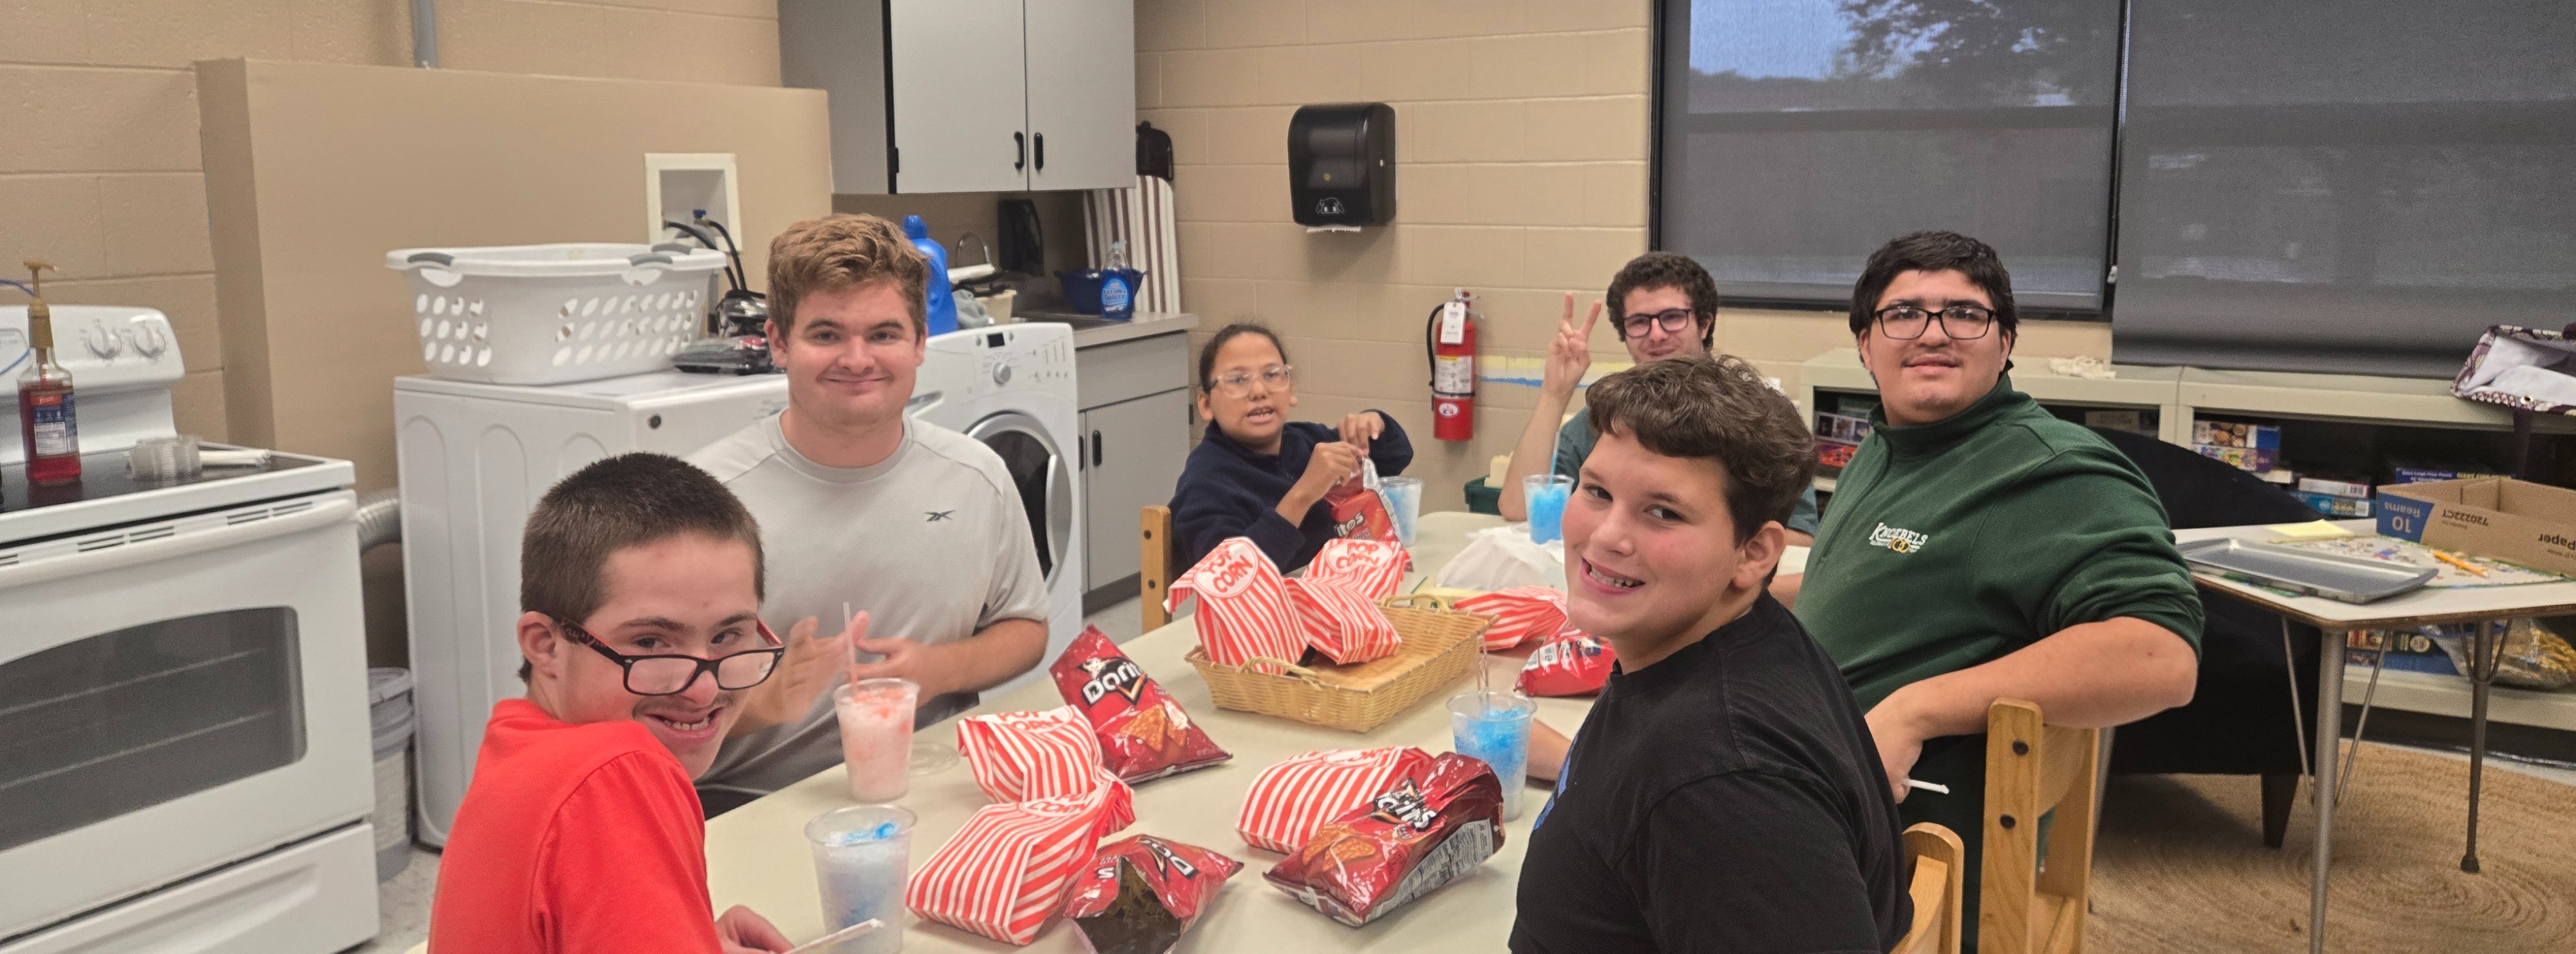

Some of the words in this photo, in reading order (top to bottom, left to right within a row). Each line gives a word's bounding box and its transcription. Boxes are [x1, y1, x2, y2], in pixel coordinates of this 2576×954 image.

[2384, 501, 2421, 518] Reams
[2392, 515, 2412, 533] 10
[1868, 522, 1928, 546] KNOEBELS
[2538, 533, 2576, 551] Paper
[1346, 541, 1379, 555] POP
[1335, 554, 1384, 569] CORN
[1213, 554, 1253, 593] CORN
